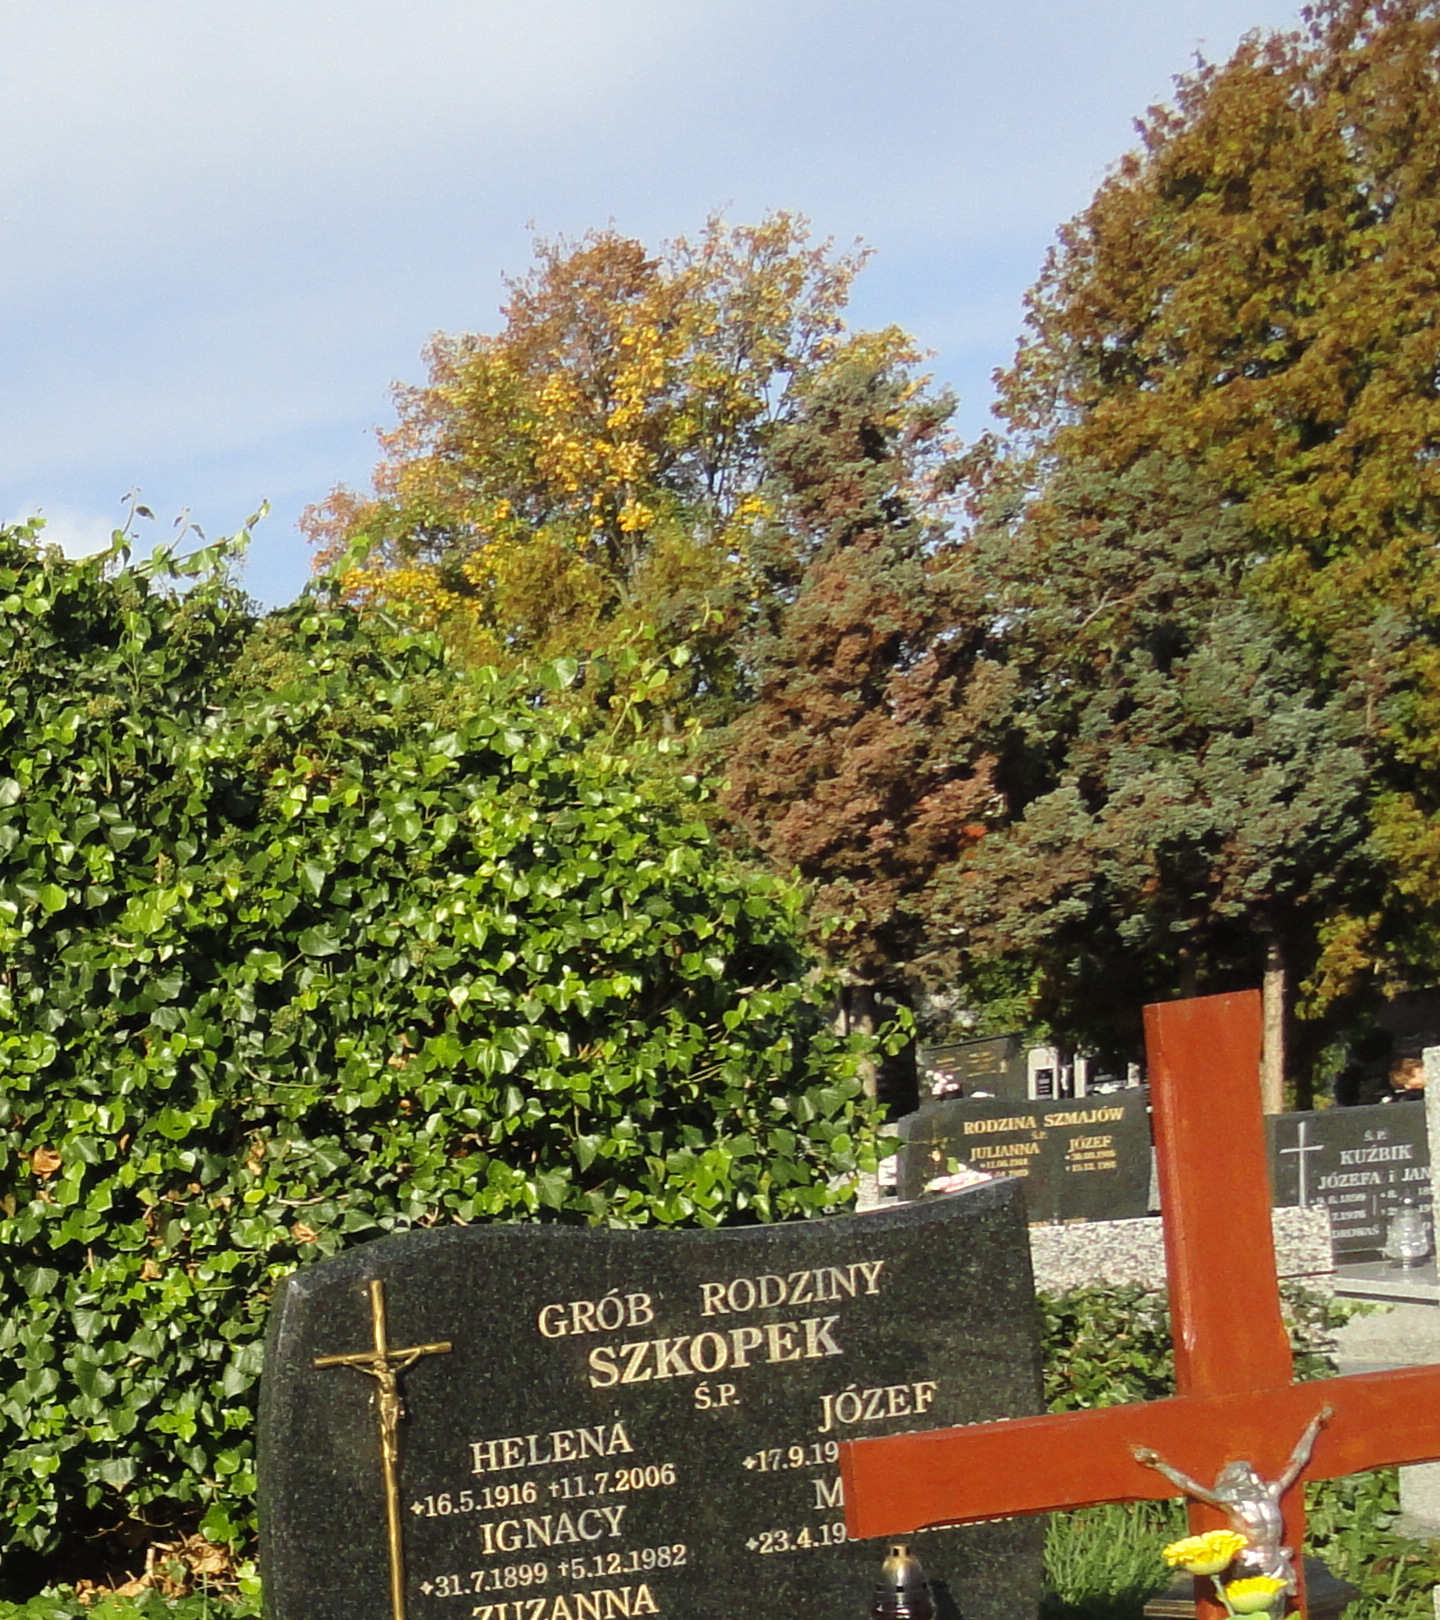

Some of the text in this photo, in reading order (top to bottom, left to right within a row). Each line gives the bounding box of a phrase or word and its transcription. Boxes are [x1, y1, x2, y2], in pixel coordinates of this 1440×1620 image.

[963, 1106, 1125, 1136] RODZINA SZMAJÓW
[969, 1142, 1041, 1163] JULIANNA
[1068, 1135, 1113, 1153] JÓZEF
[1339, 1144, 1413, 1165] KUŹBIK
[1317, 1172, 1381, 1190] JÓZEFA
[1389, 1170, 1395, 1183] i
[537, 1260, 885, 1339] GRÓB RODZINY
[588, 1315, 844, 1390] SZKOPEK
[693, 1381, 741, 1411] Ś.P.
[817, 1380, 938, 1434] JÓZEF
[469, 1422, 634, 1475] HELENA
[755, 1440, 839, 1473] 17.9.19
[424, 1462, 677, 1518] 16.5.1916 11.7.2006
[479, 1504, 628, 1555] IGNACY
[759, 1522, 848, 1556] 23.4.19
[434, 1543, 688, 1597] 31.7.1899 5.12.1982
